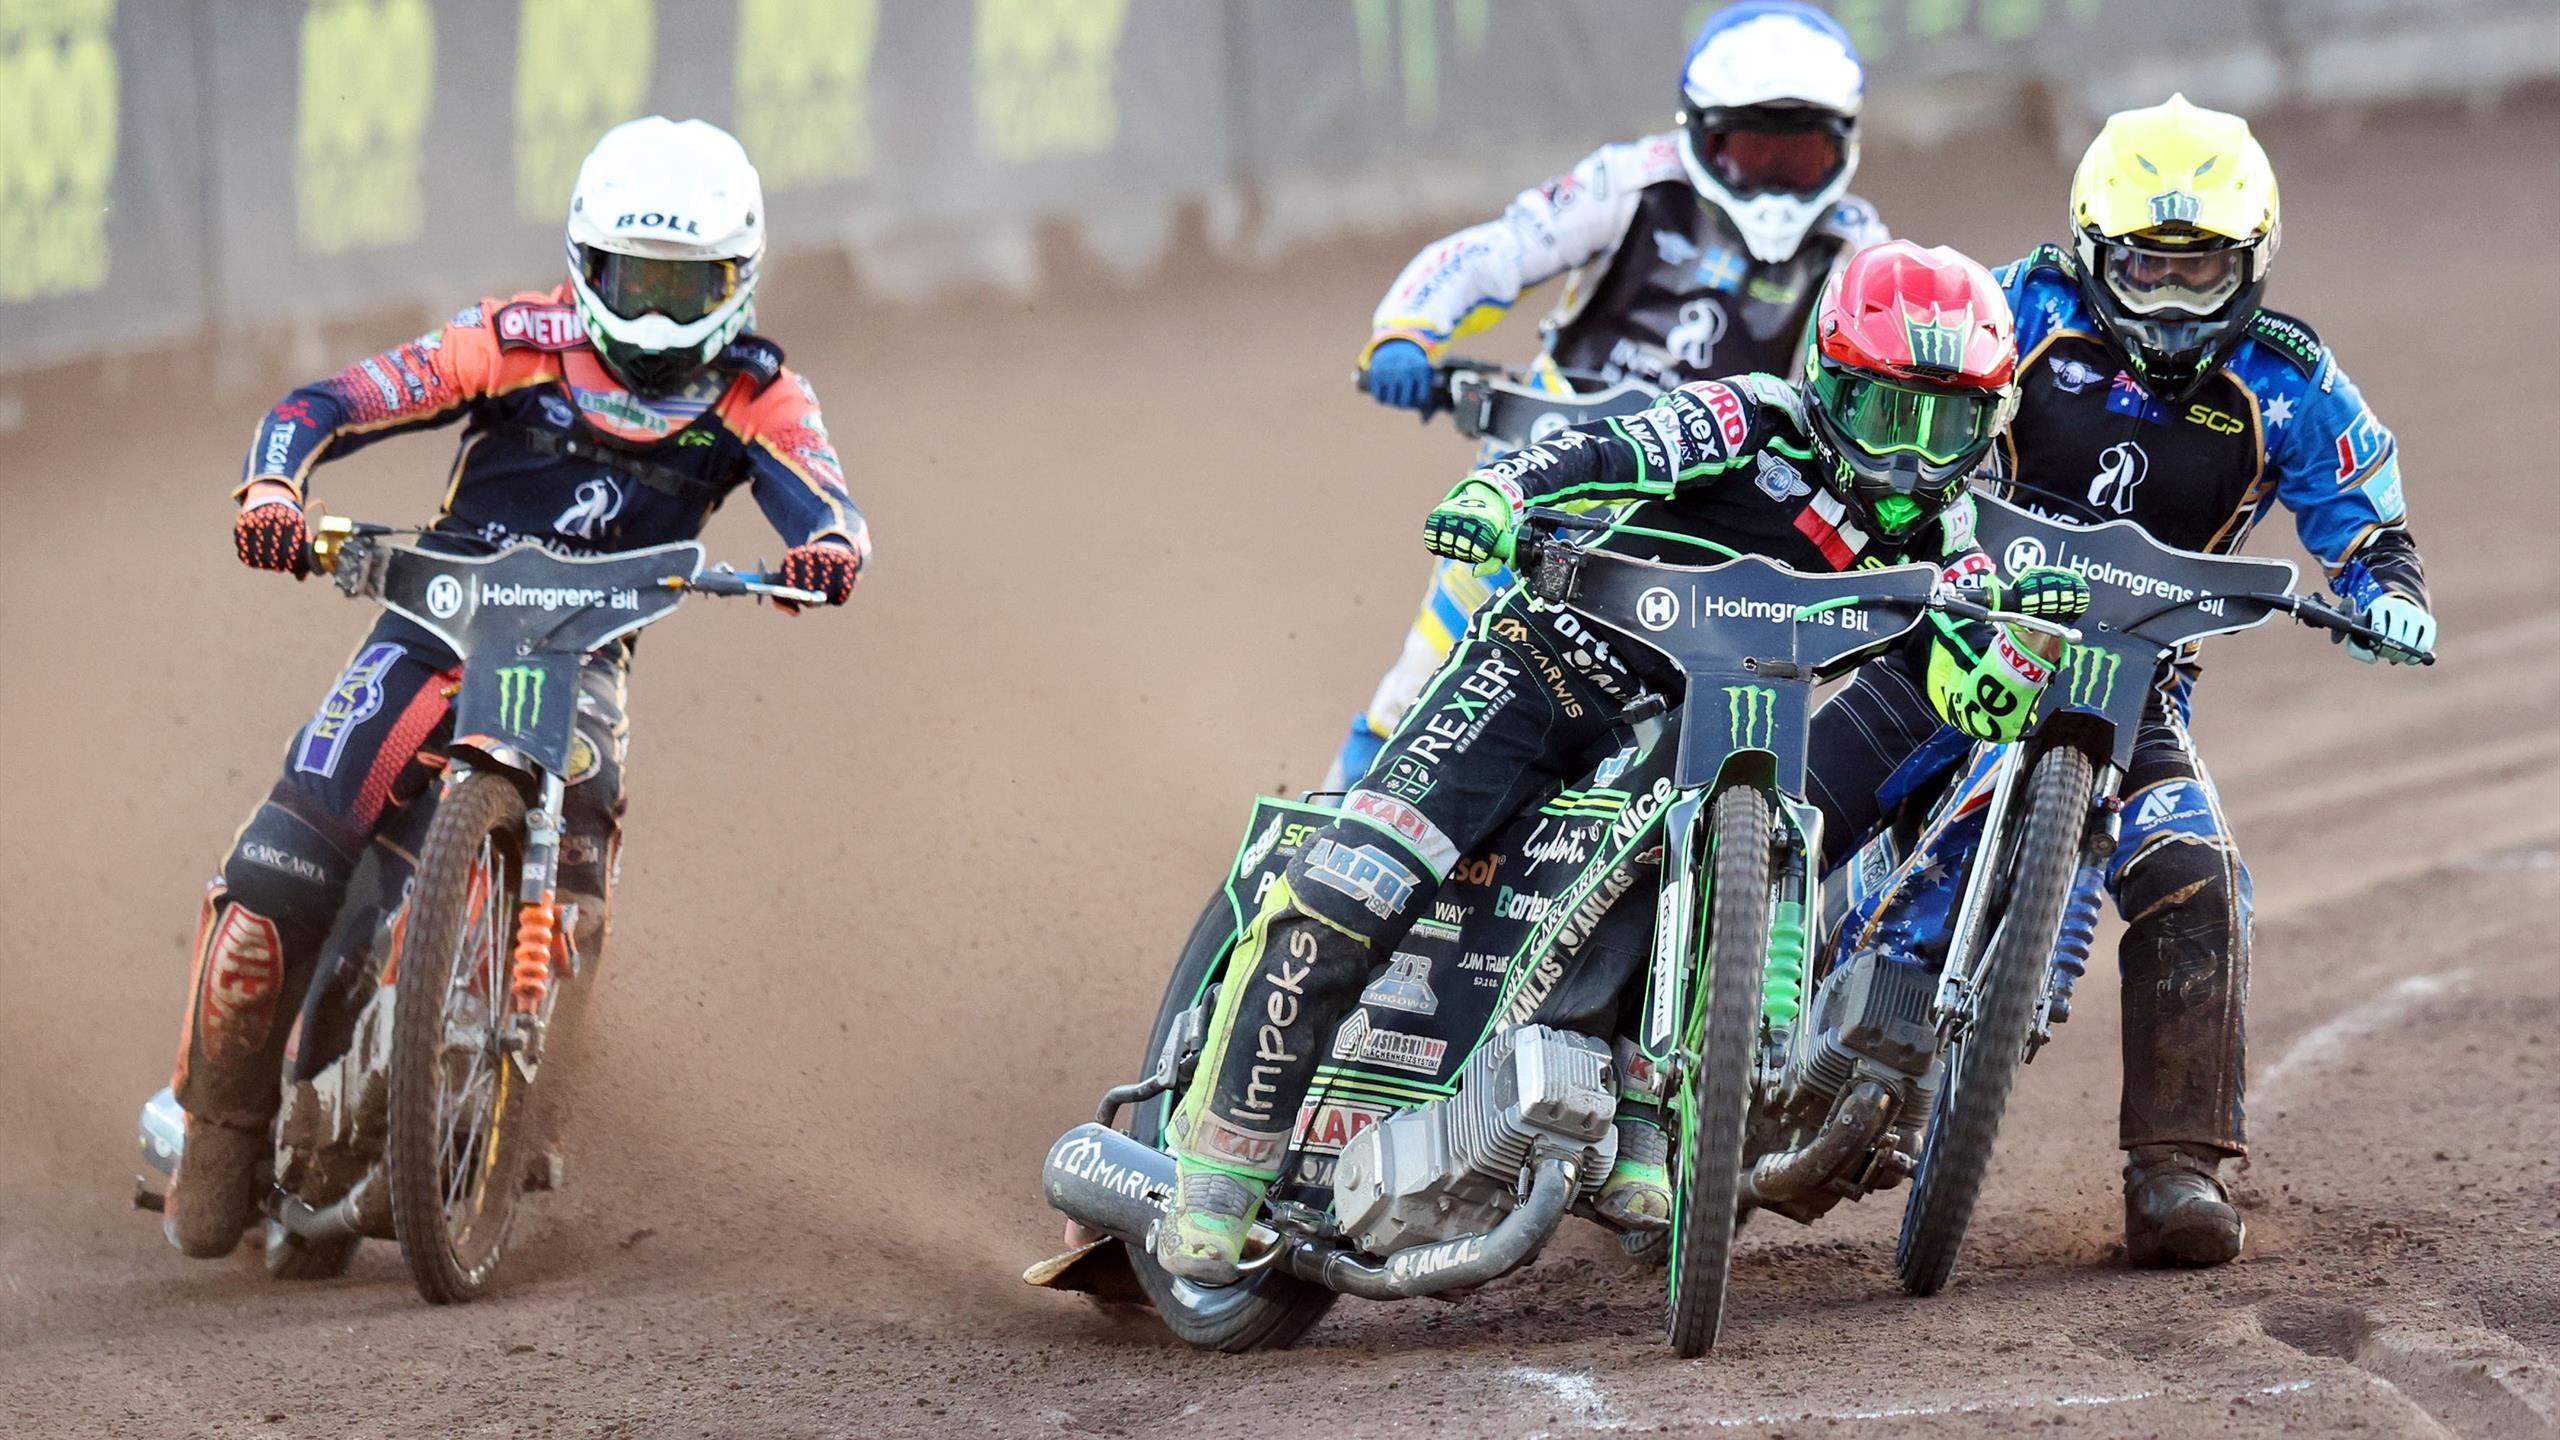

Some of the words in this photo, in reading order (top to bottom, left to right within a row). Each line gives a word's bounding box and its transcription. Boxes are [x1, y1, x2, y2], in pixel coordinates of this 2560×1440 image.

[615, 213, 700, 235] BOLL
[2257, 326, 2315, 361] ENERGY
[2258, 316, 2321, 361] MONSTER
[1672, 393, 1720, 461] artex
[482, 582, 605, 611] Holmgrens
[611, 586, 639, 611] Bil
[2070, 554, 2194, 602] Holmgrens
[2198, 589, 2224, 617] Bil
[1841, 604, 1869, 632] Bil
[1406, 657, 1521, 765] REXER
[1455, 690, 1517, 753] engineering
[1354, 795, 1426, 841] KAPI
[1612, 777, 1673, 850] Nice
[1305, 838, 1414, 915] ARPOL
[1494, 885, 1557, 922] Bartex
[1369, 992, 1430, 1010] ROGOWO
[1230, 930, 1318, 1121] Impeks
[1295, 1106, 1384, 1146] KAP
